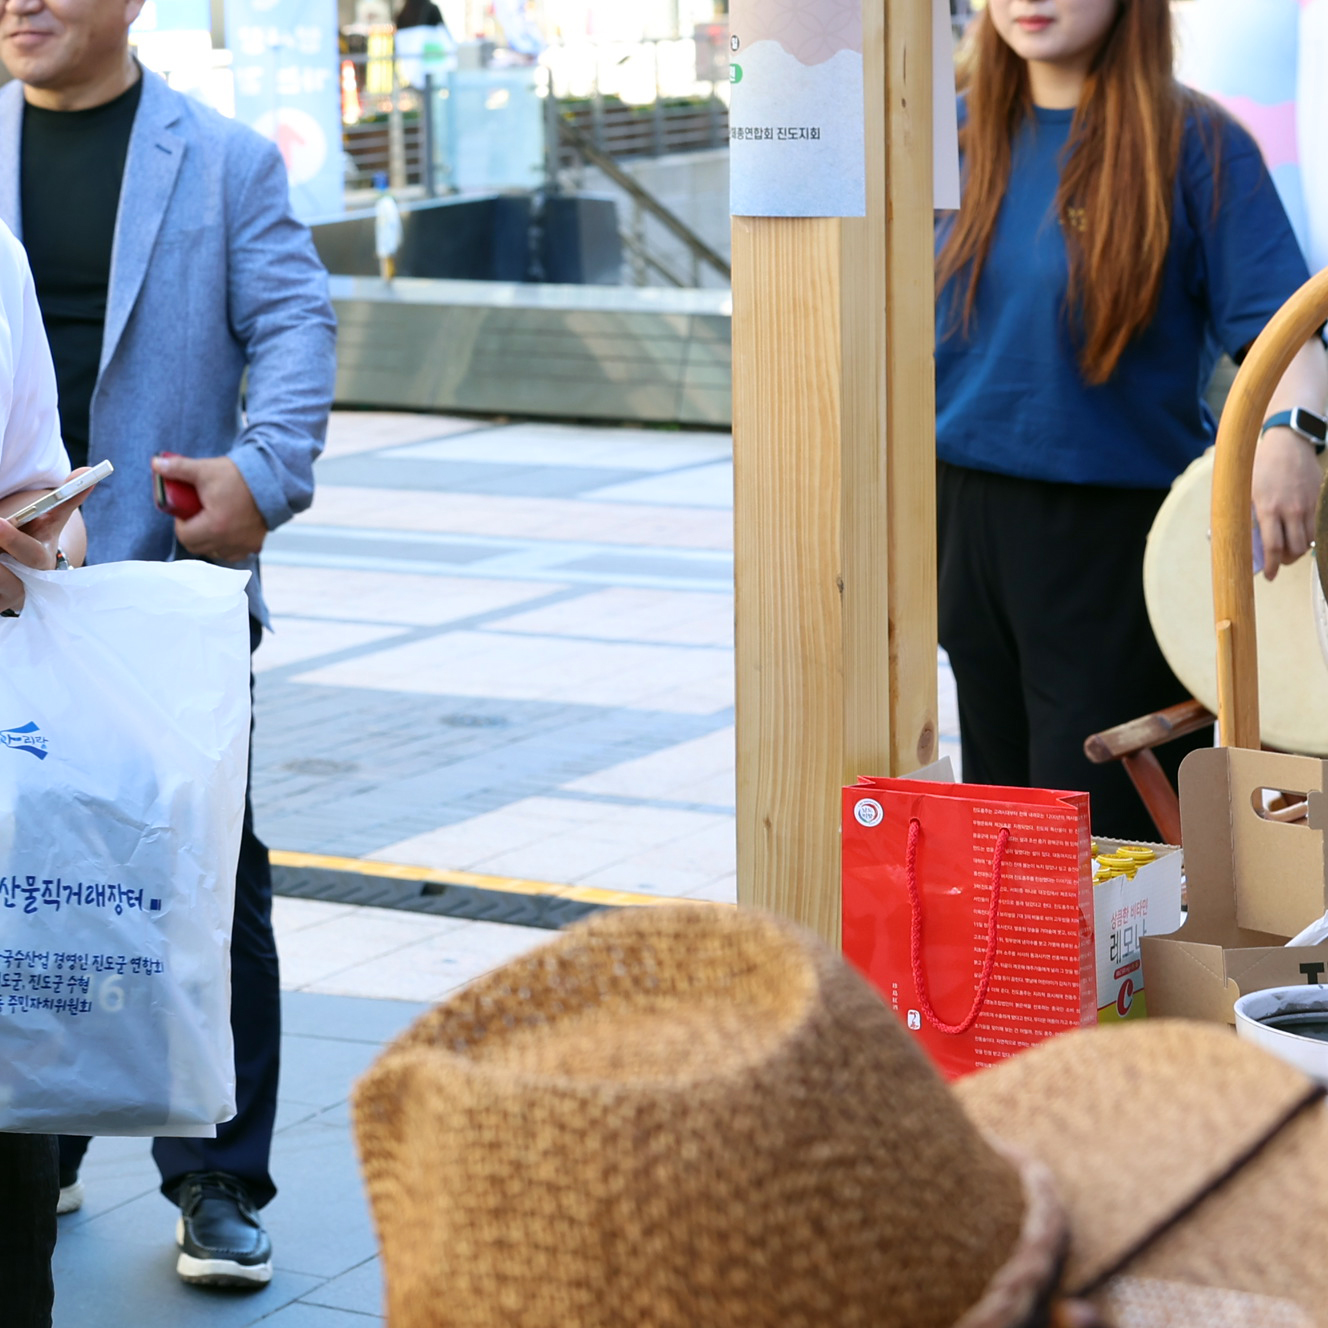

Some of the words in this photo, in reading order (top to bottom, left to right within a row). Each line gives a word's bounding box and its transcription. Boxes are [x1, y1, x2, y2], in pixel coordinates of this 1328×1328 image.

[777, 127, 820, 140] 진도지회
[1111, 907, 1130, 931] 상큼한
[1130, 898, 1149, 921] 비타민
[53, 951, 89, 971] 경영인
[92, 954, 127, 975] 진도군
[28, 973, 64, 994] 진도군
[67, 975, 91, 994] 수협
[1117, 978, 1134, 1016] C
